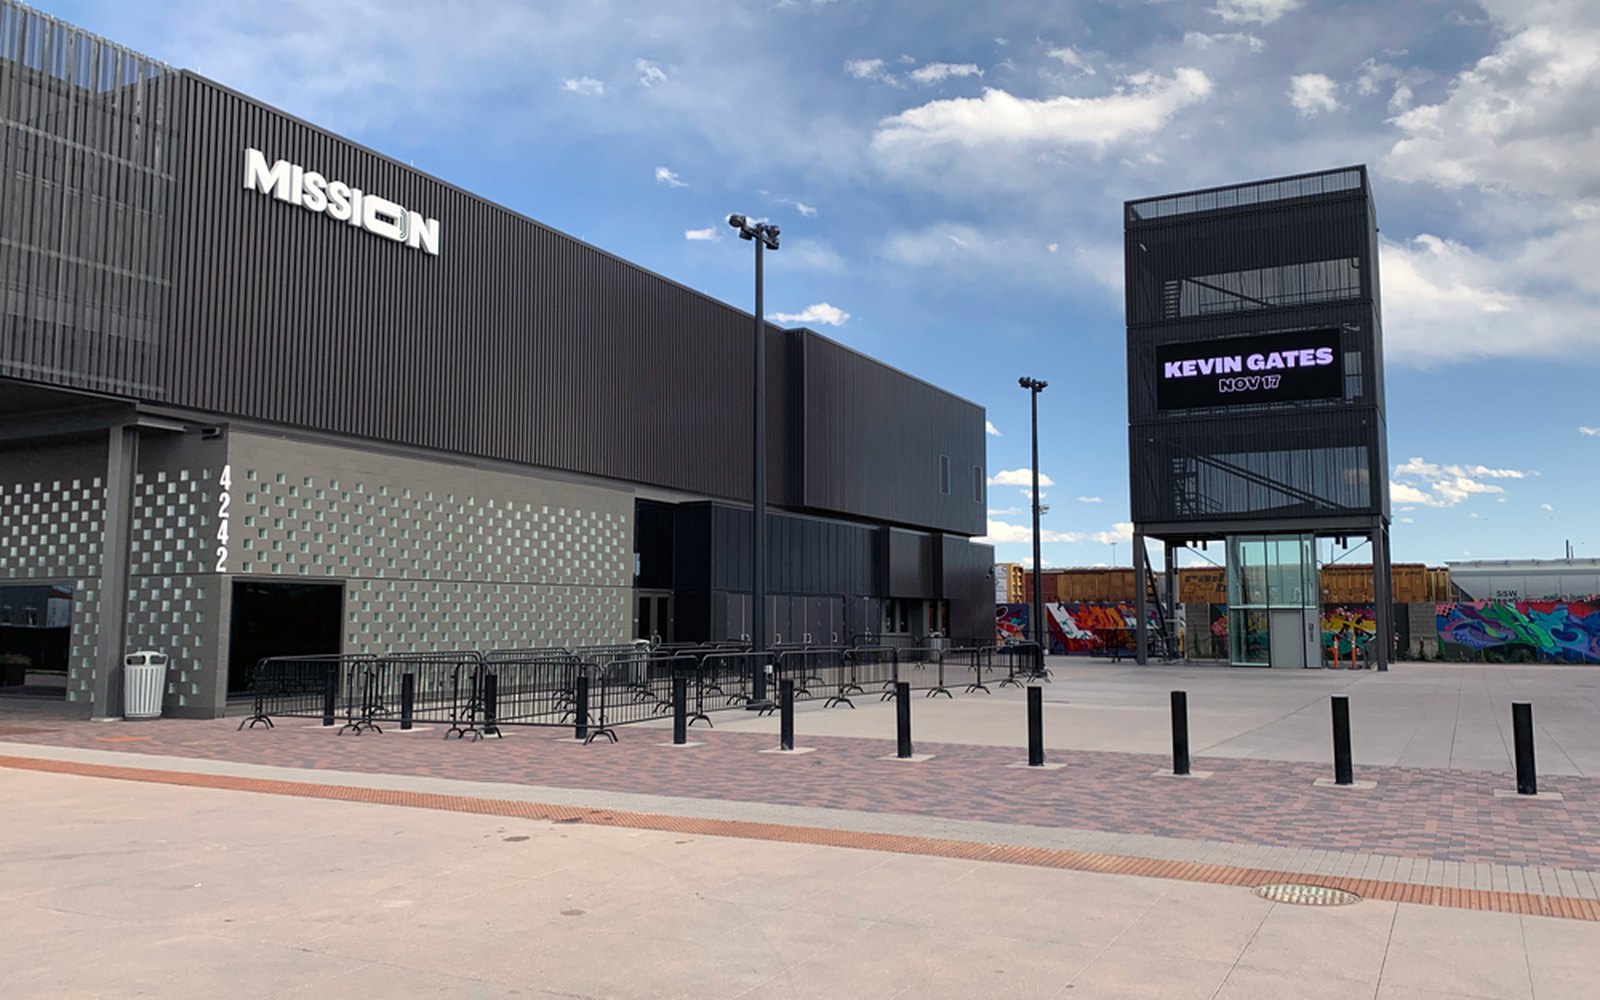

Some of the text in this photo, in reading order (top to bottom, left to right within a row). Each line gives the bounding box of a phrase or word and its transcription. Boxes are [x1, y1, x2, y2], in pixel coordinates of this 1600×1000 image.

[243, 147, 440, 256] MISSION
[1164, 347, 1334, 379] KEVIN GATES
[1219, 374, 1281, 392] NOV 17
[215, 464, 232, 572] 4242
[1496, 590, 1518, 598] SSW
